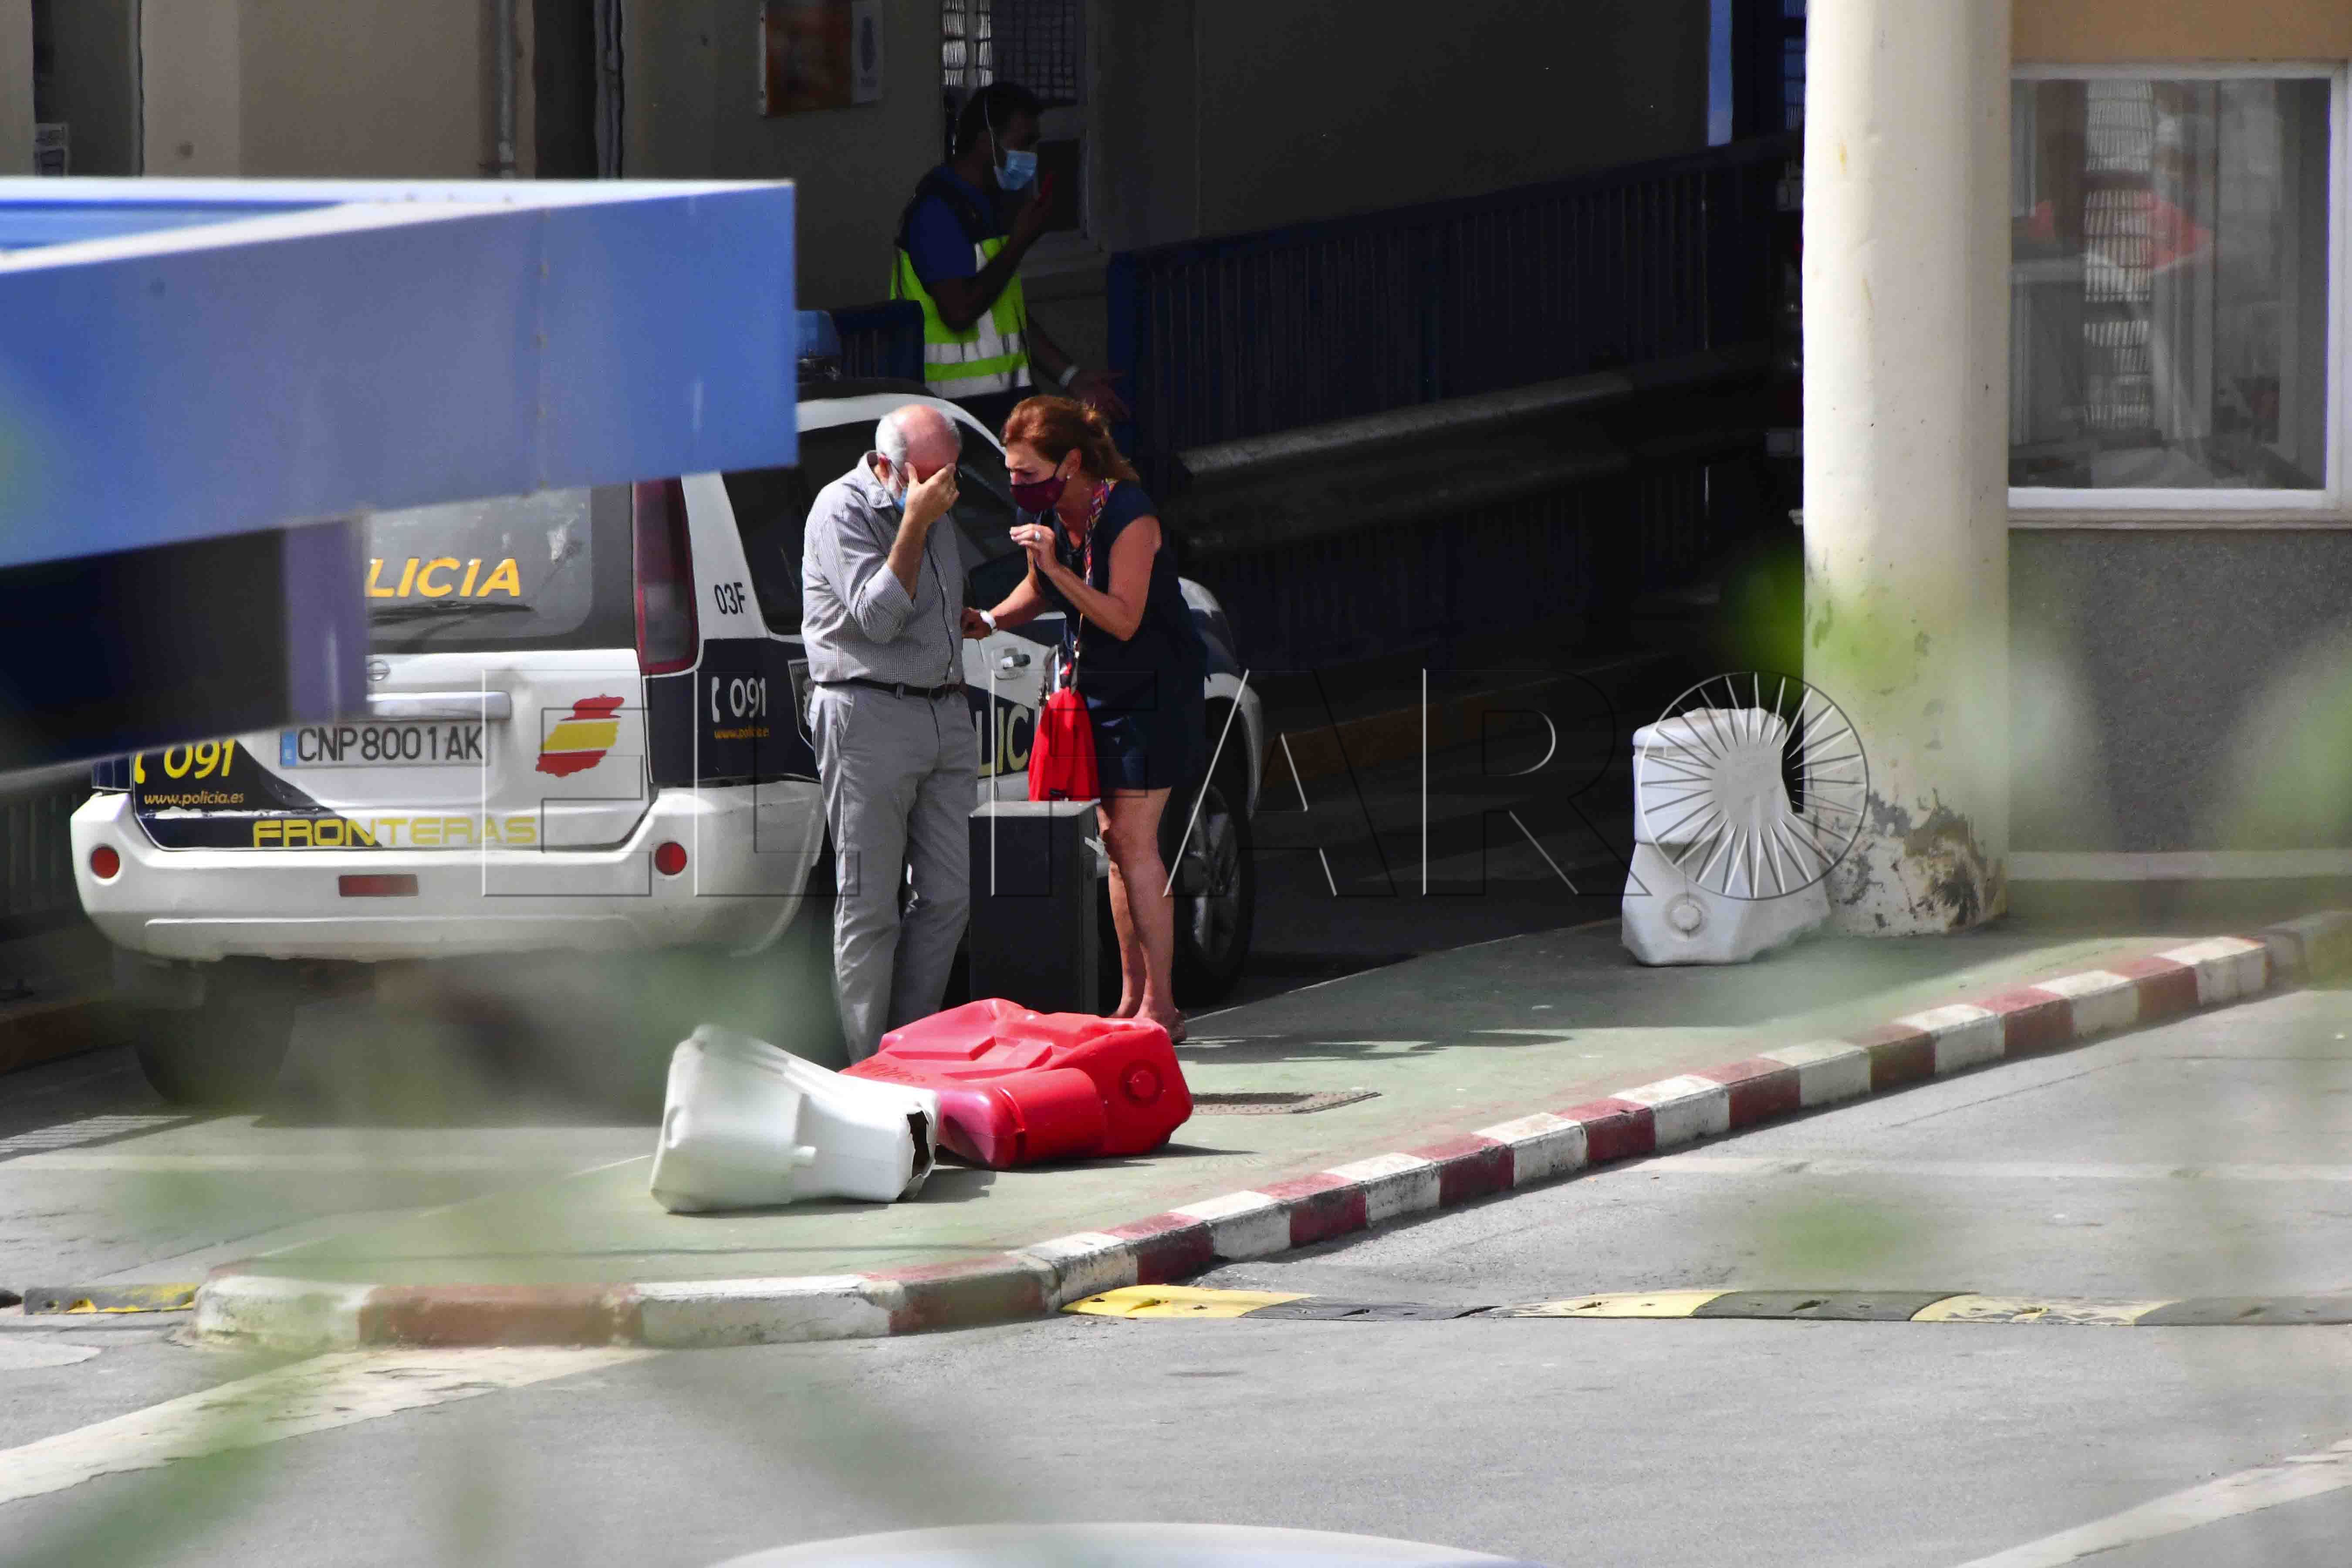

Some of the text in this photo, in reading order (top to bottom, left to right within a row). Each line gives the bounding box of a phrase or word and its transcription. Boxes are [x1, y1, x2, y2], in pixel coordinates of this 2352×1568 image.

[365, 558, 520, 598] LICIA
[714, 582, 746, 615] 03F
[730, 676, 766, 718] 091
[164, 738, 236, 779] 091
[144, 790, 244, 806] www.policia.es
[253, 816, 536, 848] FRONTERAS
